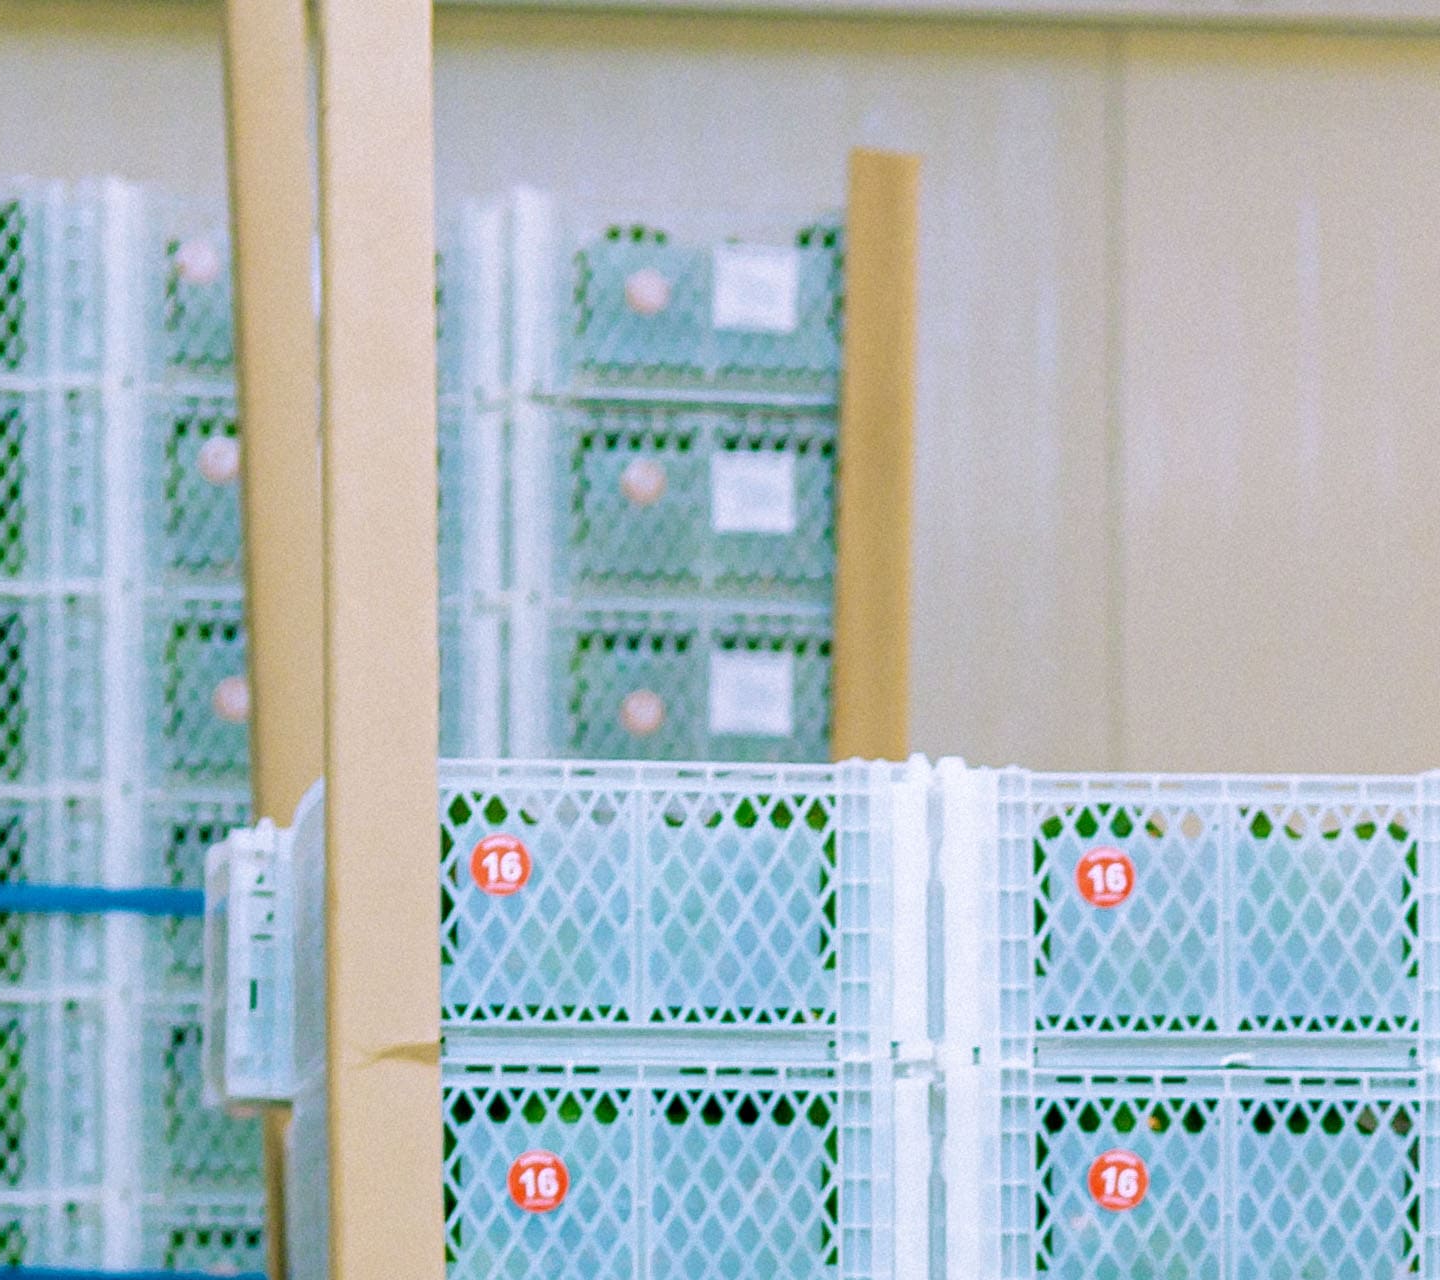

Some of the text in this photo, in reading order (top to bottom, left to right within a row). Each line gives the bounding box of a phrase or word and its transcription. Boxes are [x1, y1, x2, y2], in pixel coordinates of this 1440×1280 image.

[482, 851, 522, 882] 16
[1087, 862, 1127, 894] 16
[519, 1167, 559, 1199] 16
[1101, 1165, 1138, 1198] 16
